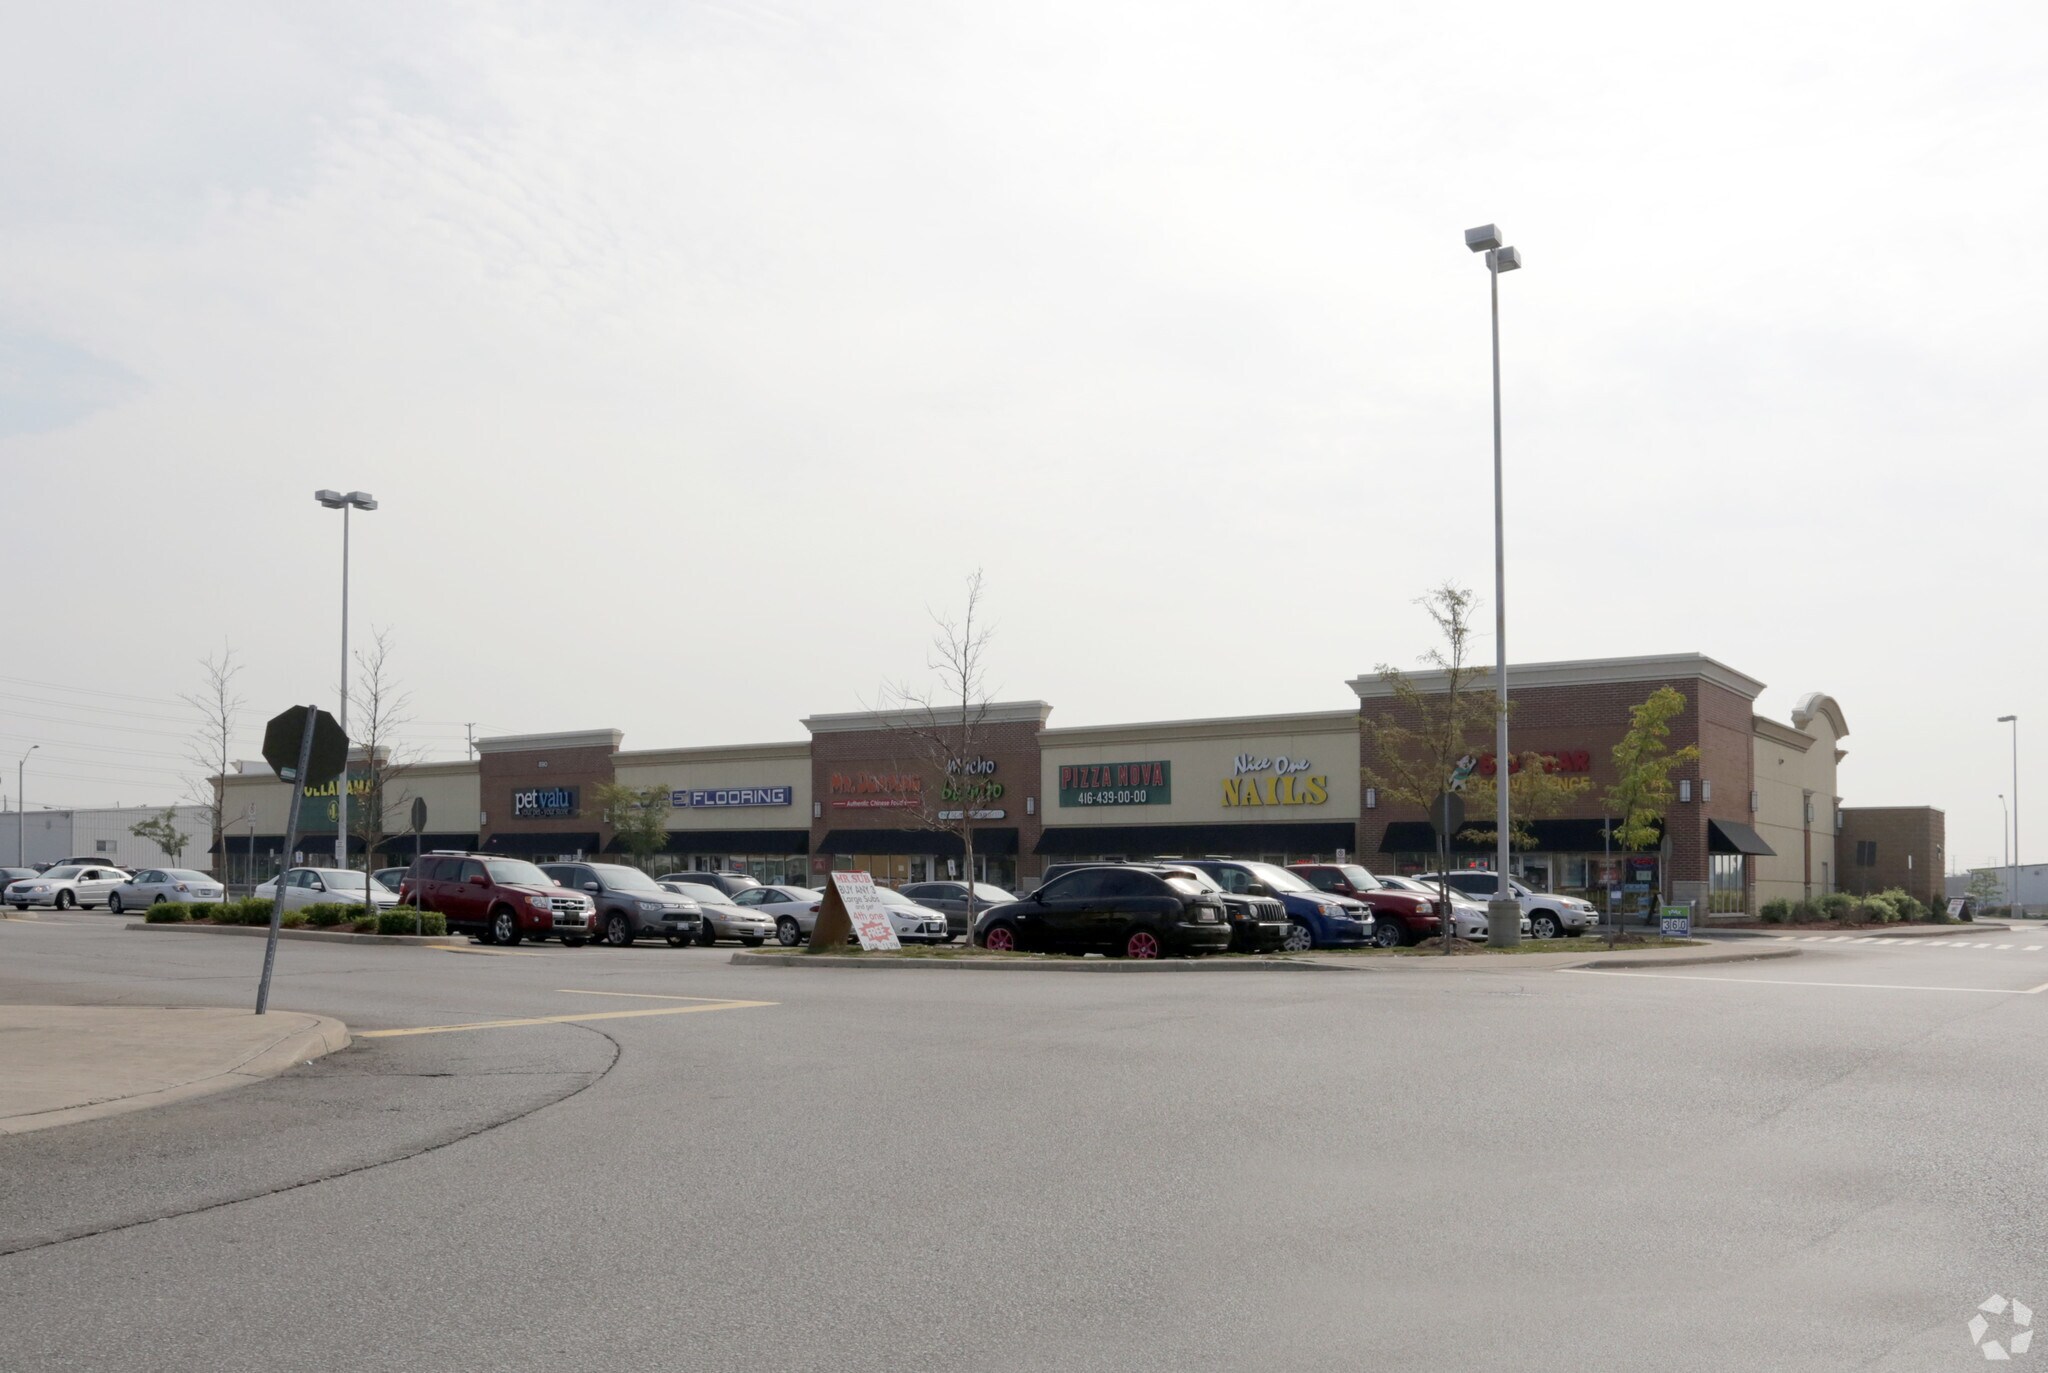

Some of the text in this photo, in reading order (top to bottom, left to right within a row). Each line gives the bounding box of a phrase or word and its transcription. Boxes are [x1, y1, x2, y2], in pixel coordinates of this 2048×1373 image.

[1234, 753, 1311, 776] Nice One
[1479, 752, 1521, 775] BG
[1061, 762, 1164, 790] PIZZA NOVA
[304, 780, 373, 797] OLLAAMA
[693, 789, 785, 805] FLOORING
[1078, 790, 1147, 804] 416-439-00-00
[1221, 775, 1328, 807] NAILS
[515, 787, 570, 815] pet valu
[839, 886, 853, 894] BUY
[855, 885, 870, 894] ANY
[843, 896, 862, 904] Large
